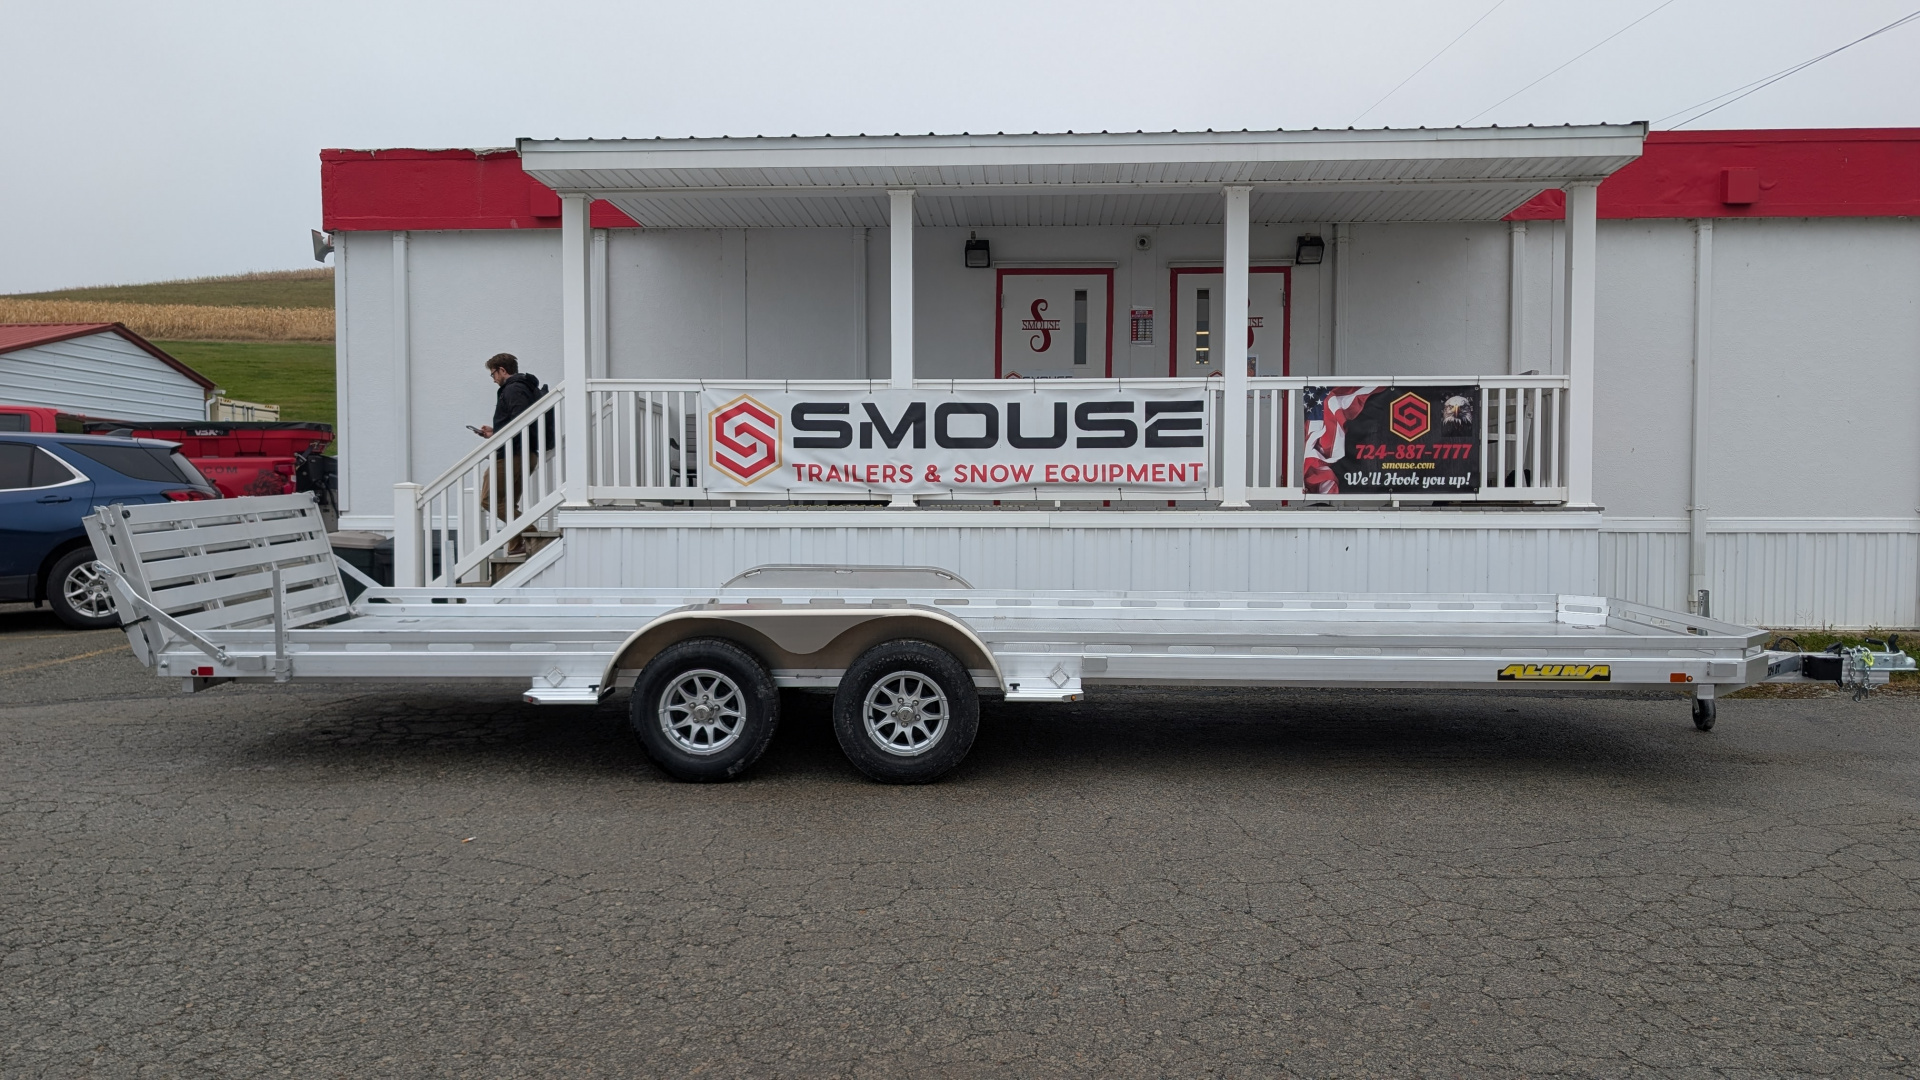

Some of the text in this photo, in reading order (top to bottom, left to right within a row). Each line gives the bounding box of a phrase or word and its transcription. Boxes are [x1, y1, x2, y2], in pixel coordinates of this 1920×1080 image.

[791, 400, 1204, 449] SMOUSE
[1355, 444, 1473, 460] 724-887-7777
[792, 463, 1204, 483] TRAILERS & SNOW EQUIPMENT
[1381, 462, 1436, 470] smouse.com
[1343, 471, 1472, 489] We'll Hook you up!
[1500, 664, 1610, 680] ALUMA
